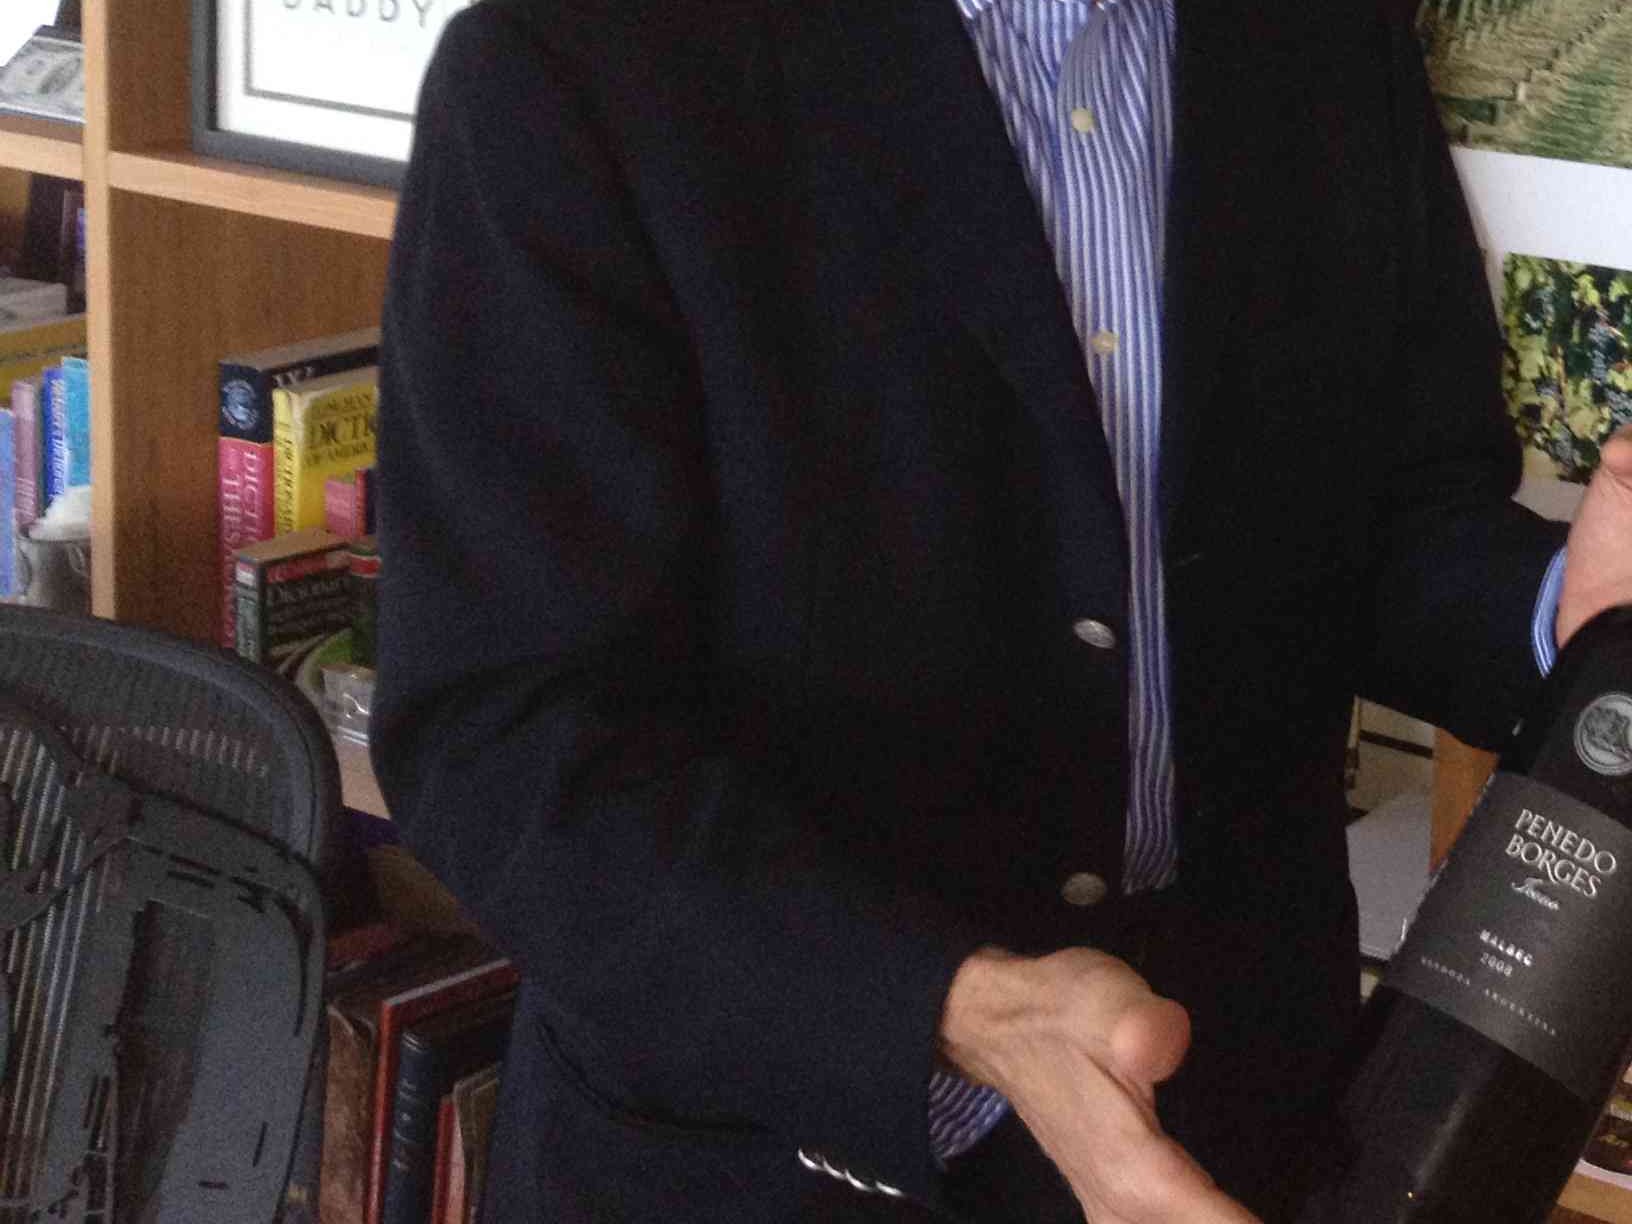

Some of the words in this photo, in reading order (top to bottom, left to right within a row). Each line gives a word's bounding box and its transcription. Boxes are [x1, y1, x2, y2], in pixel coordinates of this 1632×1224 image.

[1505, 834, 1602, 899] BORGES
[1514, 807, 1617, 874] PENEDO
[1479, 928, 1534, 967] MALBEC
